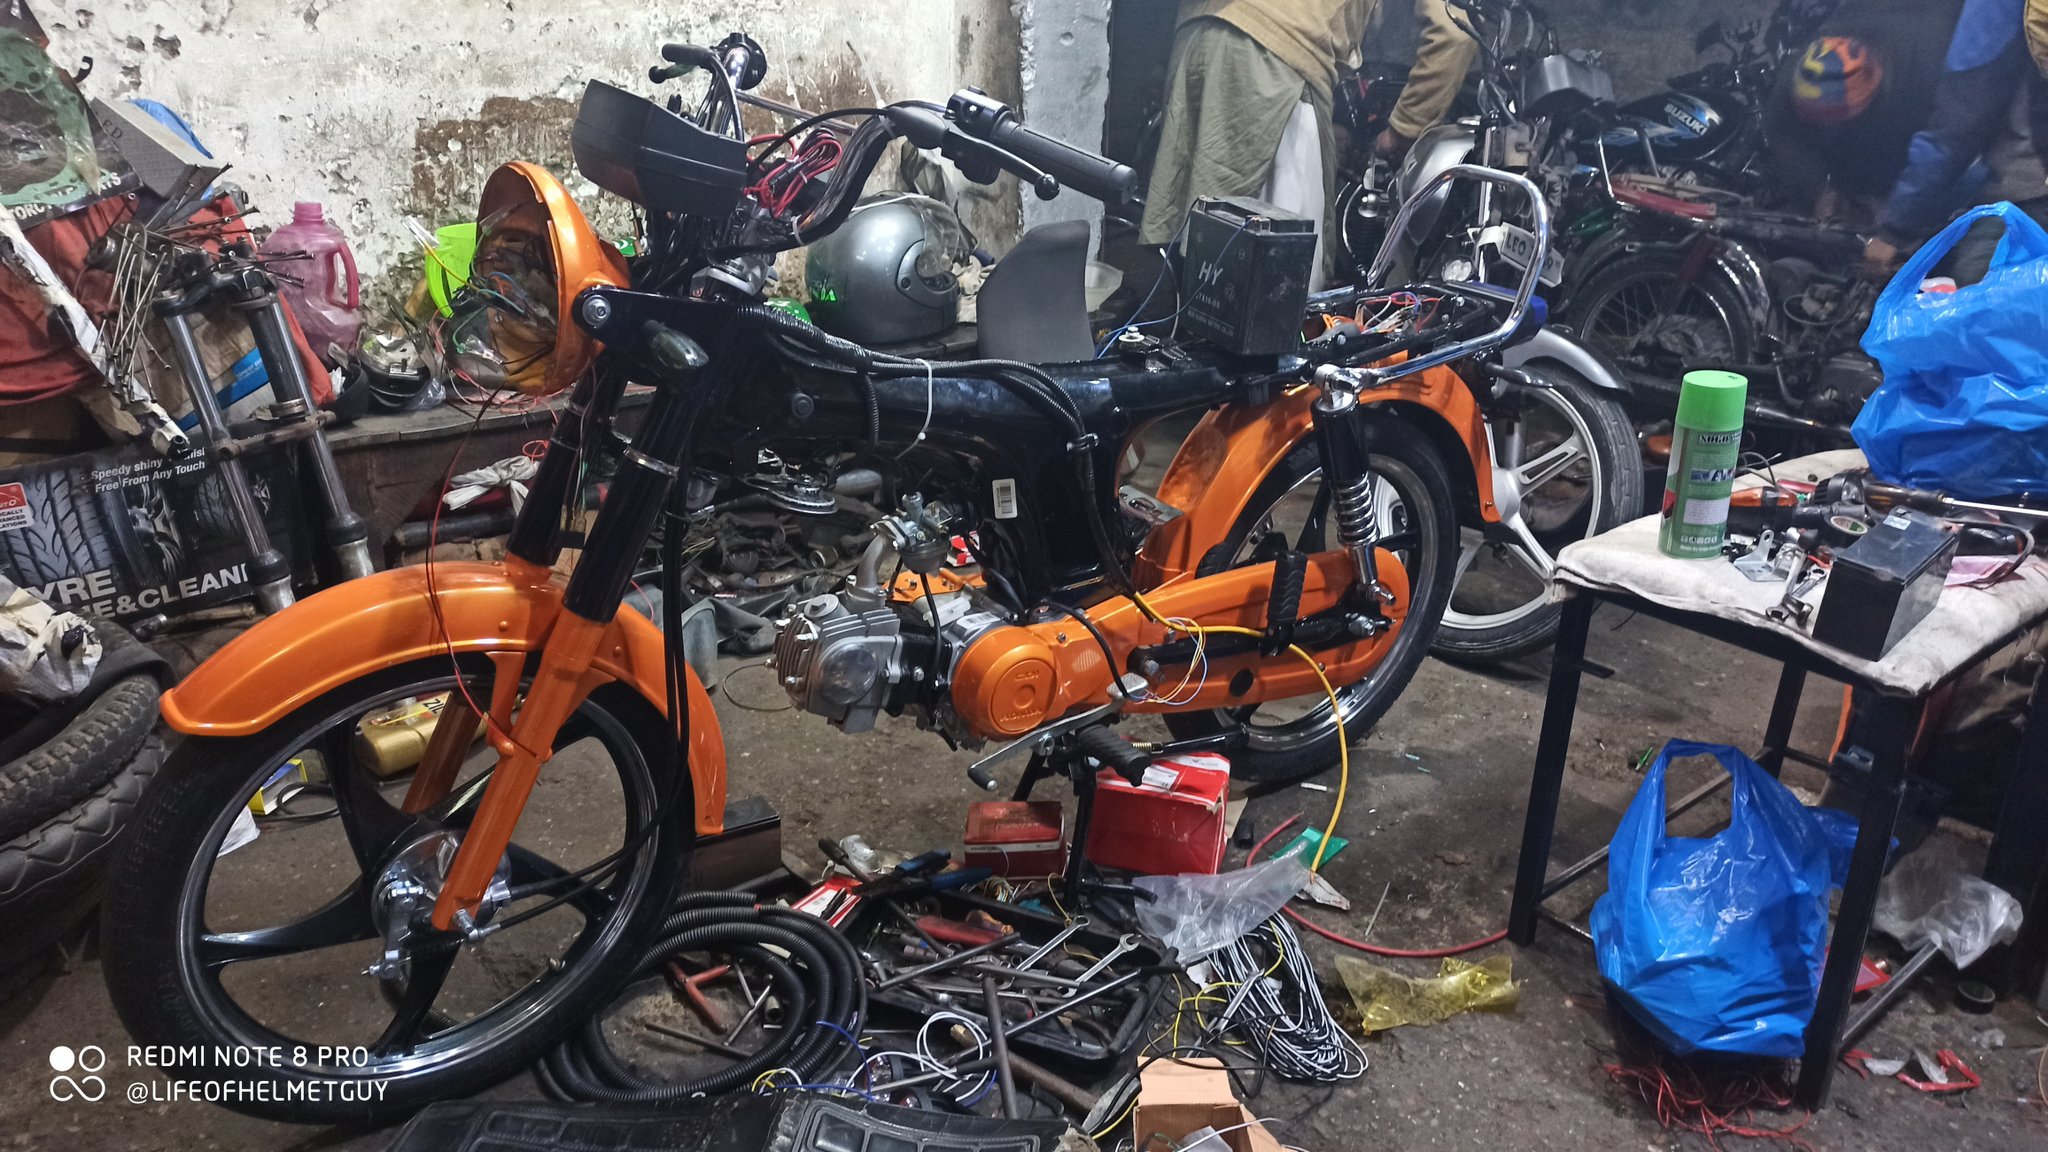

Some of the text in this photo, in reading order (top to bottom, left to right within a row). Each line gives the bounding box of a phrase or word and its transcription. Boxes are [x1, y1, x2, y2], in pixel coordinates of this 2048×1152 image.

[1664, 103, 1708, 136] SUZUKI
[1198, 260, 1223, 286] HY
[91, 464, 131, 481] Speedy
[134, 458, 163, 472] shiny
[95, 460, 205, 493] Free From Any Touch
